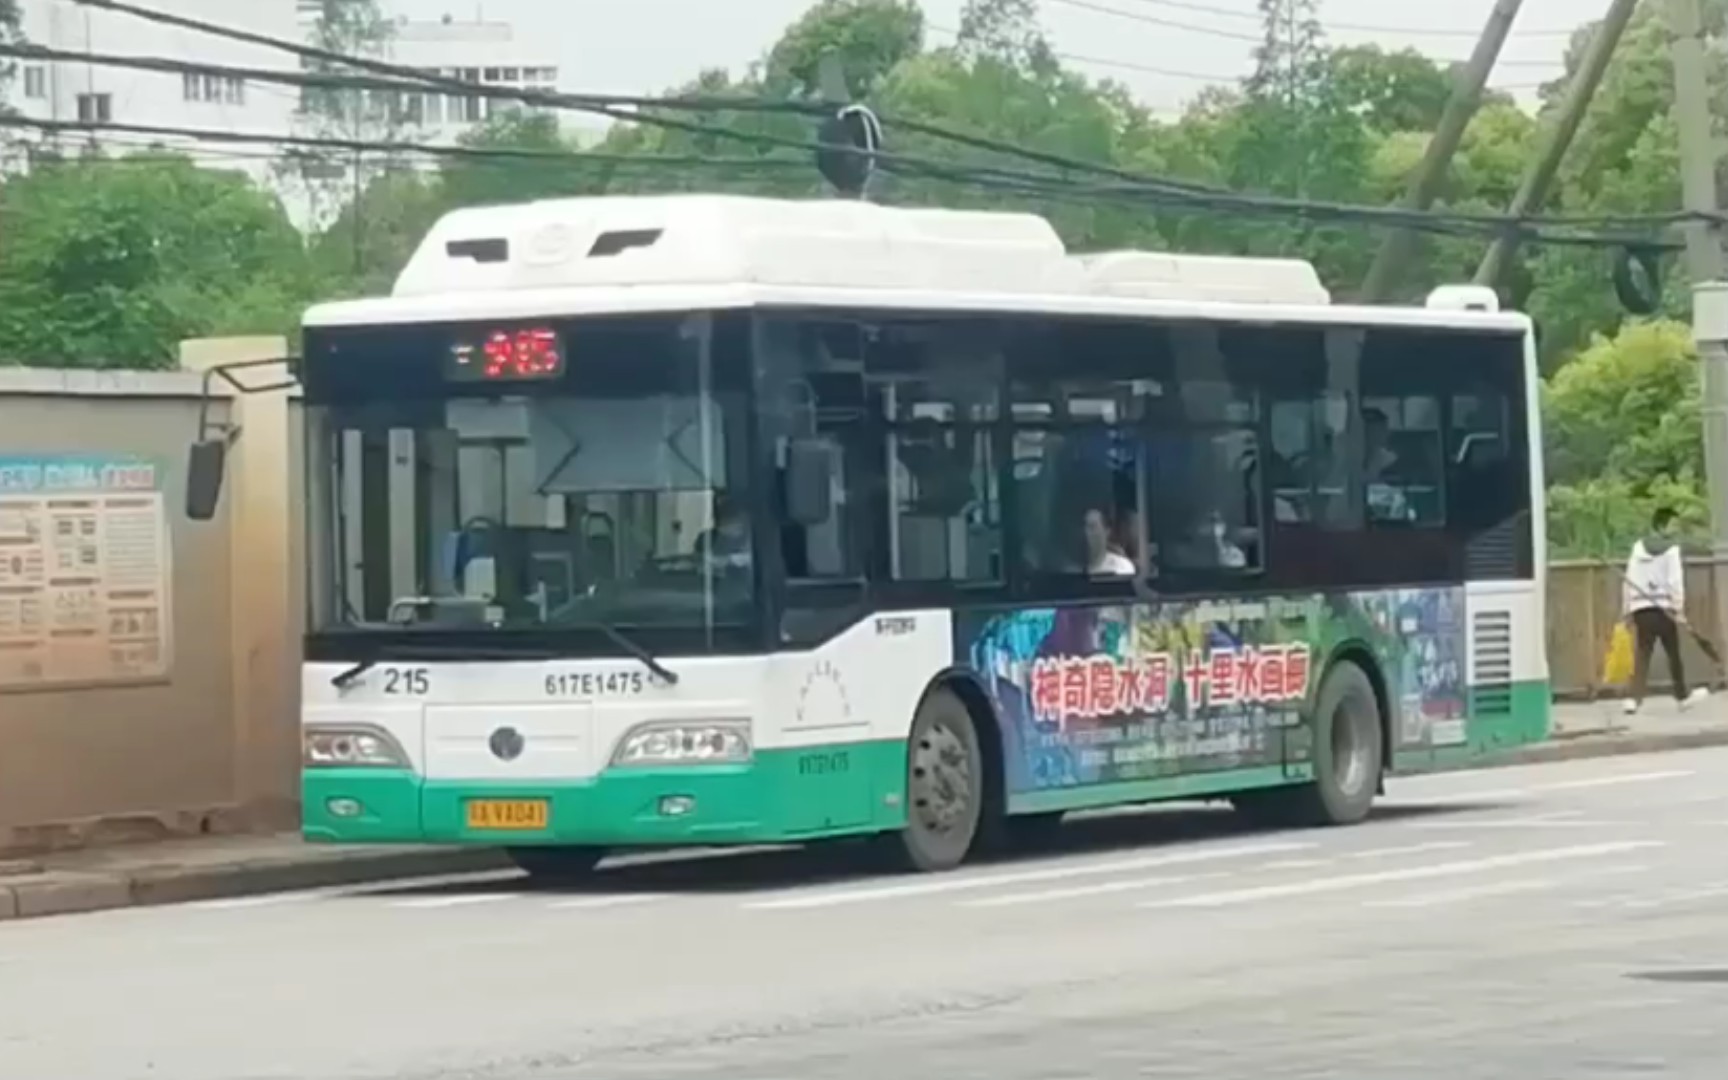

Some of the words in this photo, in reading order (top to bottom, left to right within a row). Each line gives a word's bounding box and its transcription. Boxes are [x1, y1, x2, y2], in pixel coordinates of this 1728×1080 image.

[384, 668, 429, 695] 215
[545, 671, 643, 695] 617E1475
[1031, 653, 1171, 724] 神奇隐水洞
[1184, 641, 1311, 709] 十里水画廊
